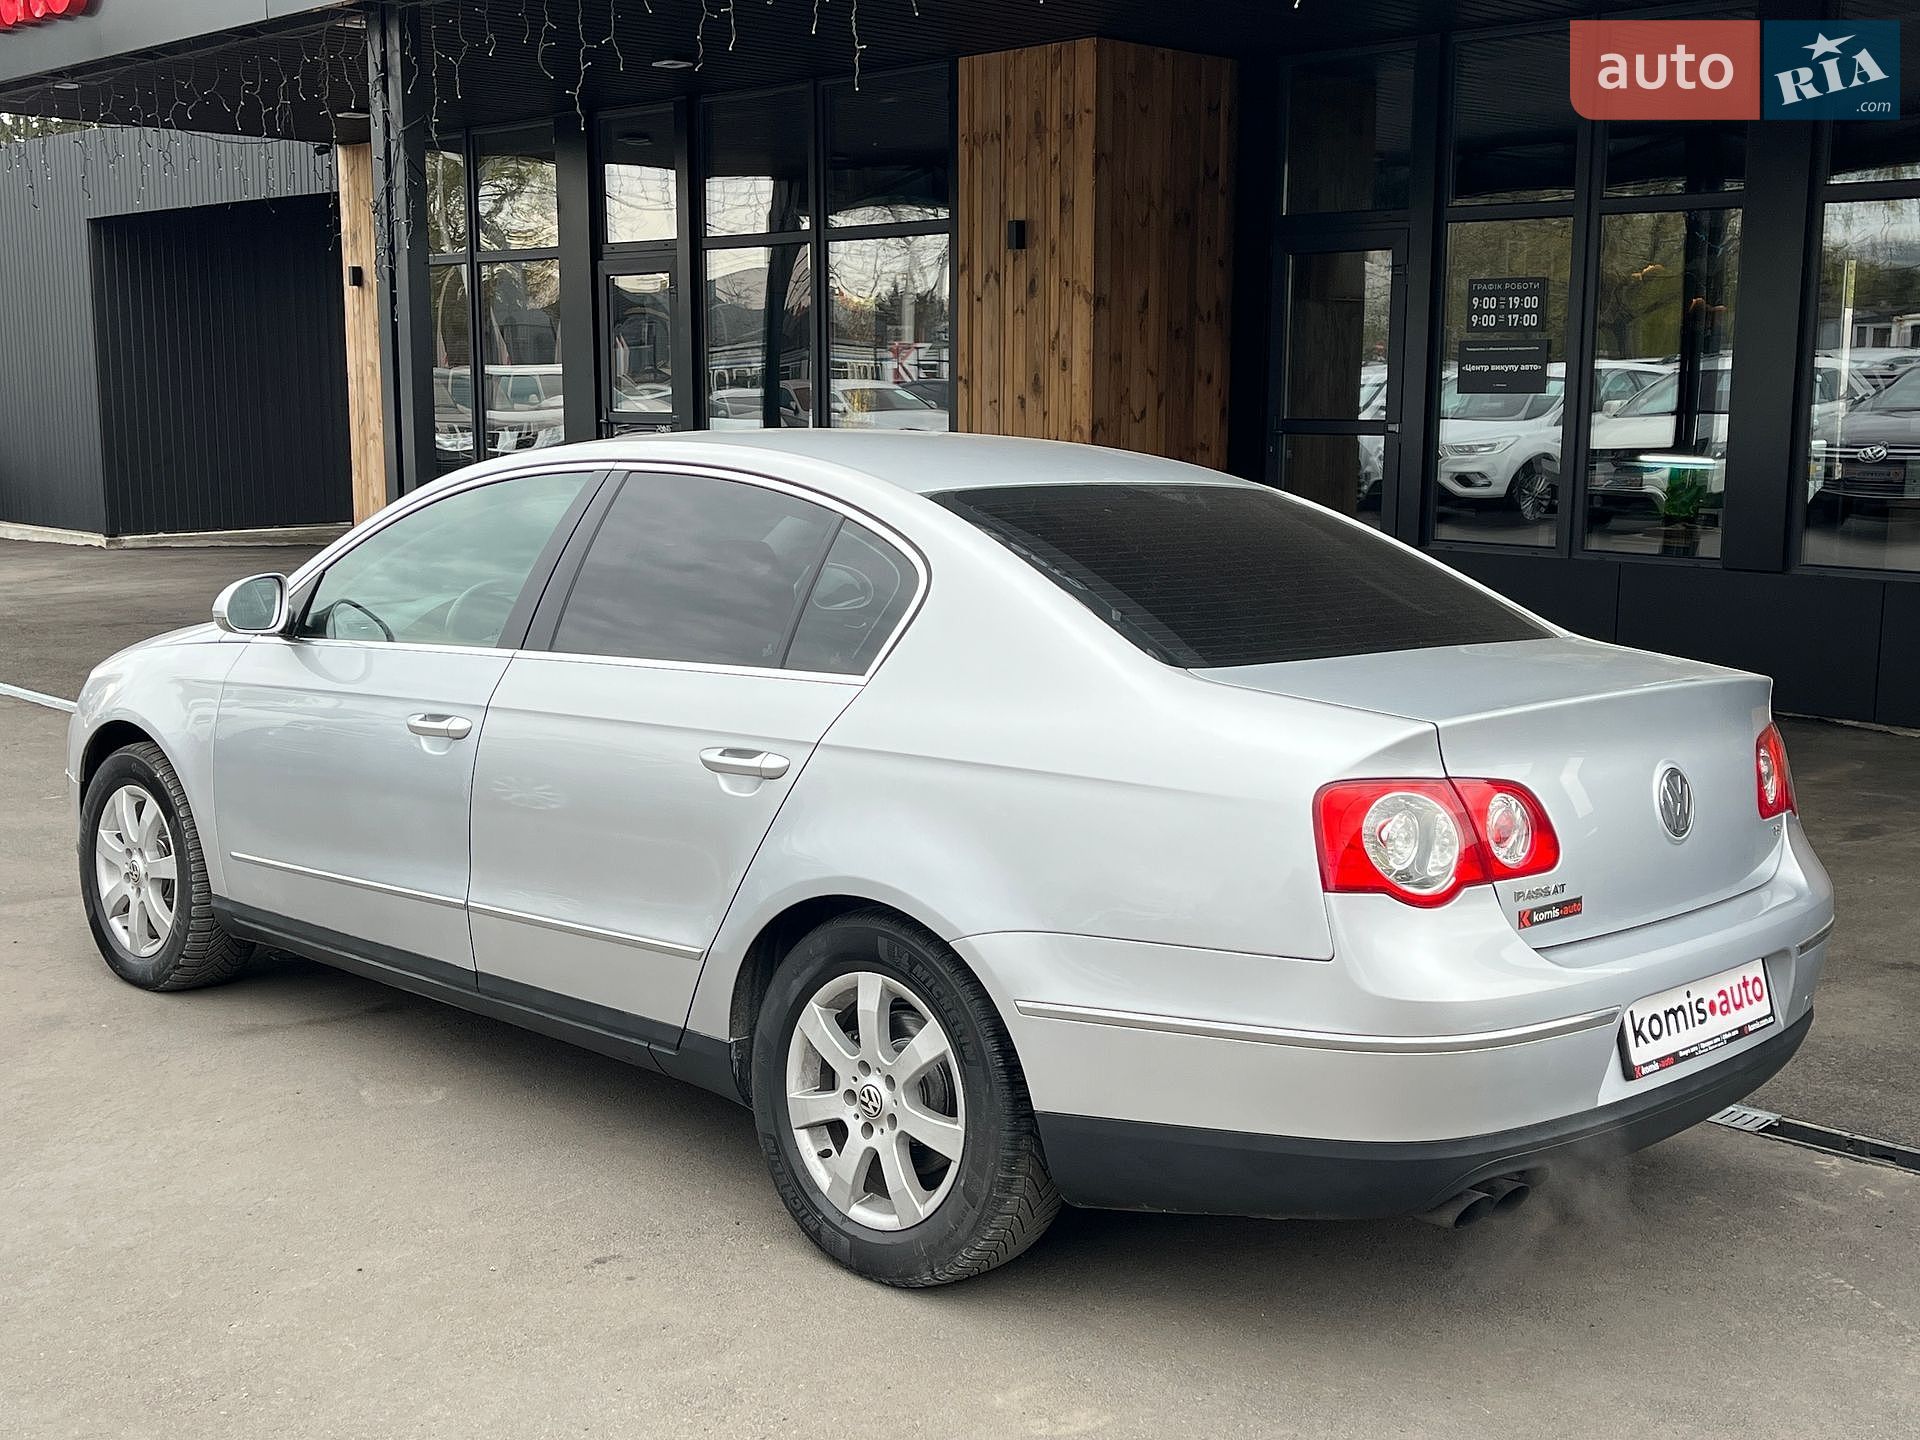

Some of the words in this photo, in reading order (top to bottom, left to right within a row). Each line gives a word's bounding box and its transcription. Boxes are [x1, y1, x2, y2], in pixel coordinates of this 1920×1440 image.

[1472, 283, 1503, 291] ГРАФІК
[1504, 282, 1540, 290] РОБОТИ
[1472, 296, 1497, 309] 9:00
[1508, 295, 1539, 309] 19:00
[1471, 314, 1496, 327] 9:00
[1507, 313, 1538, 327] 17:00
[1513, 883, 1567, 903] PASSAT
